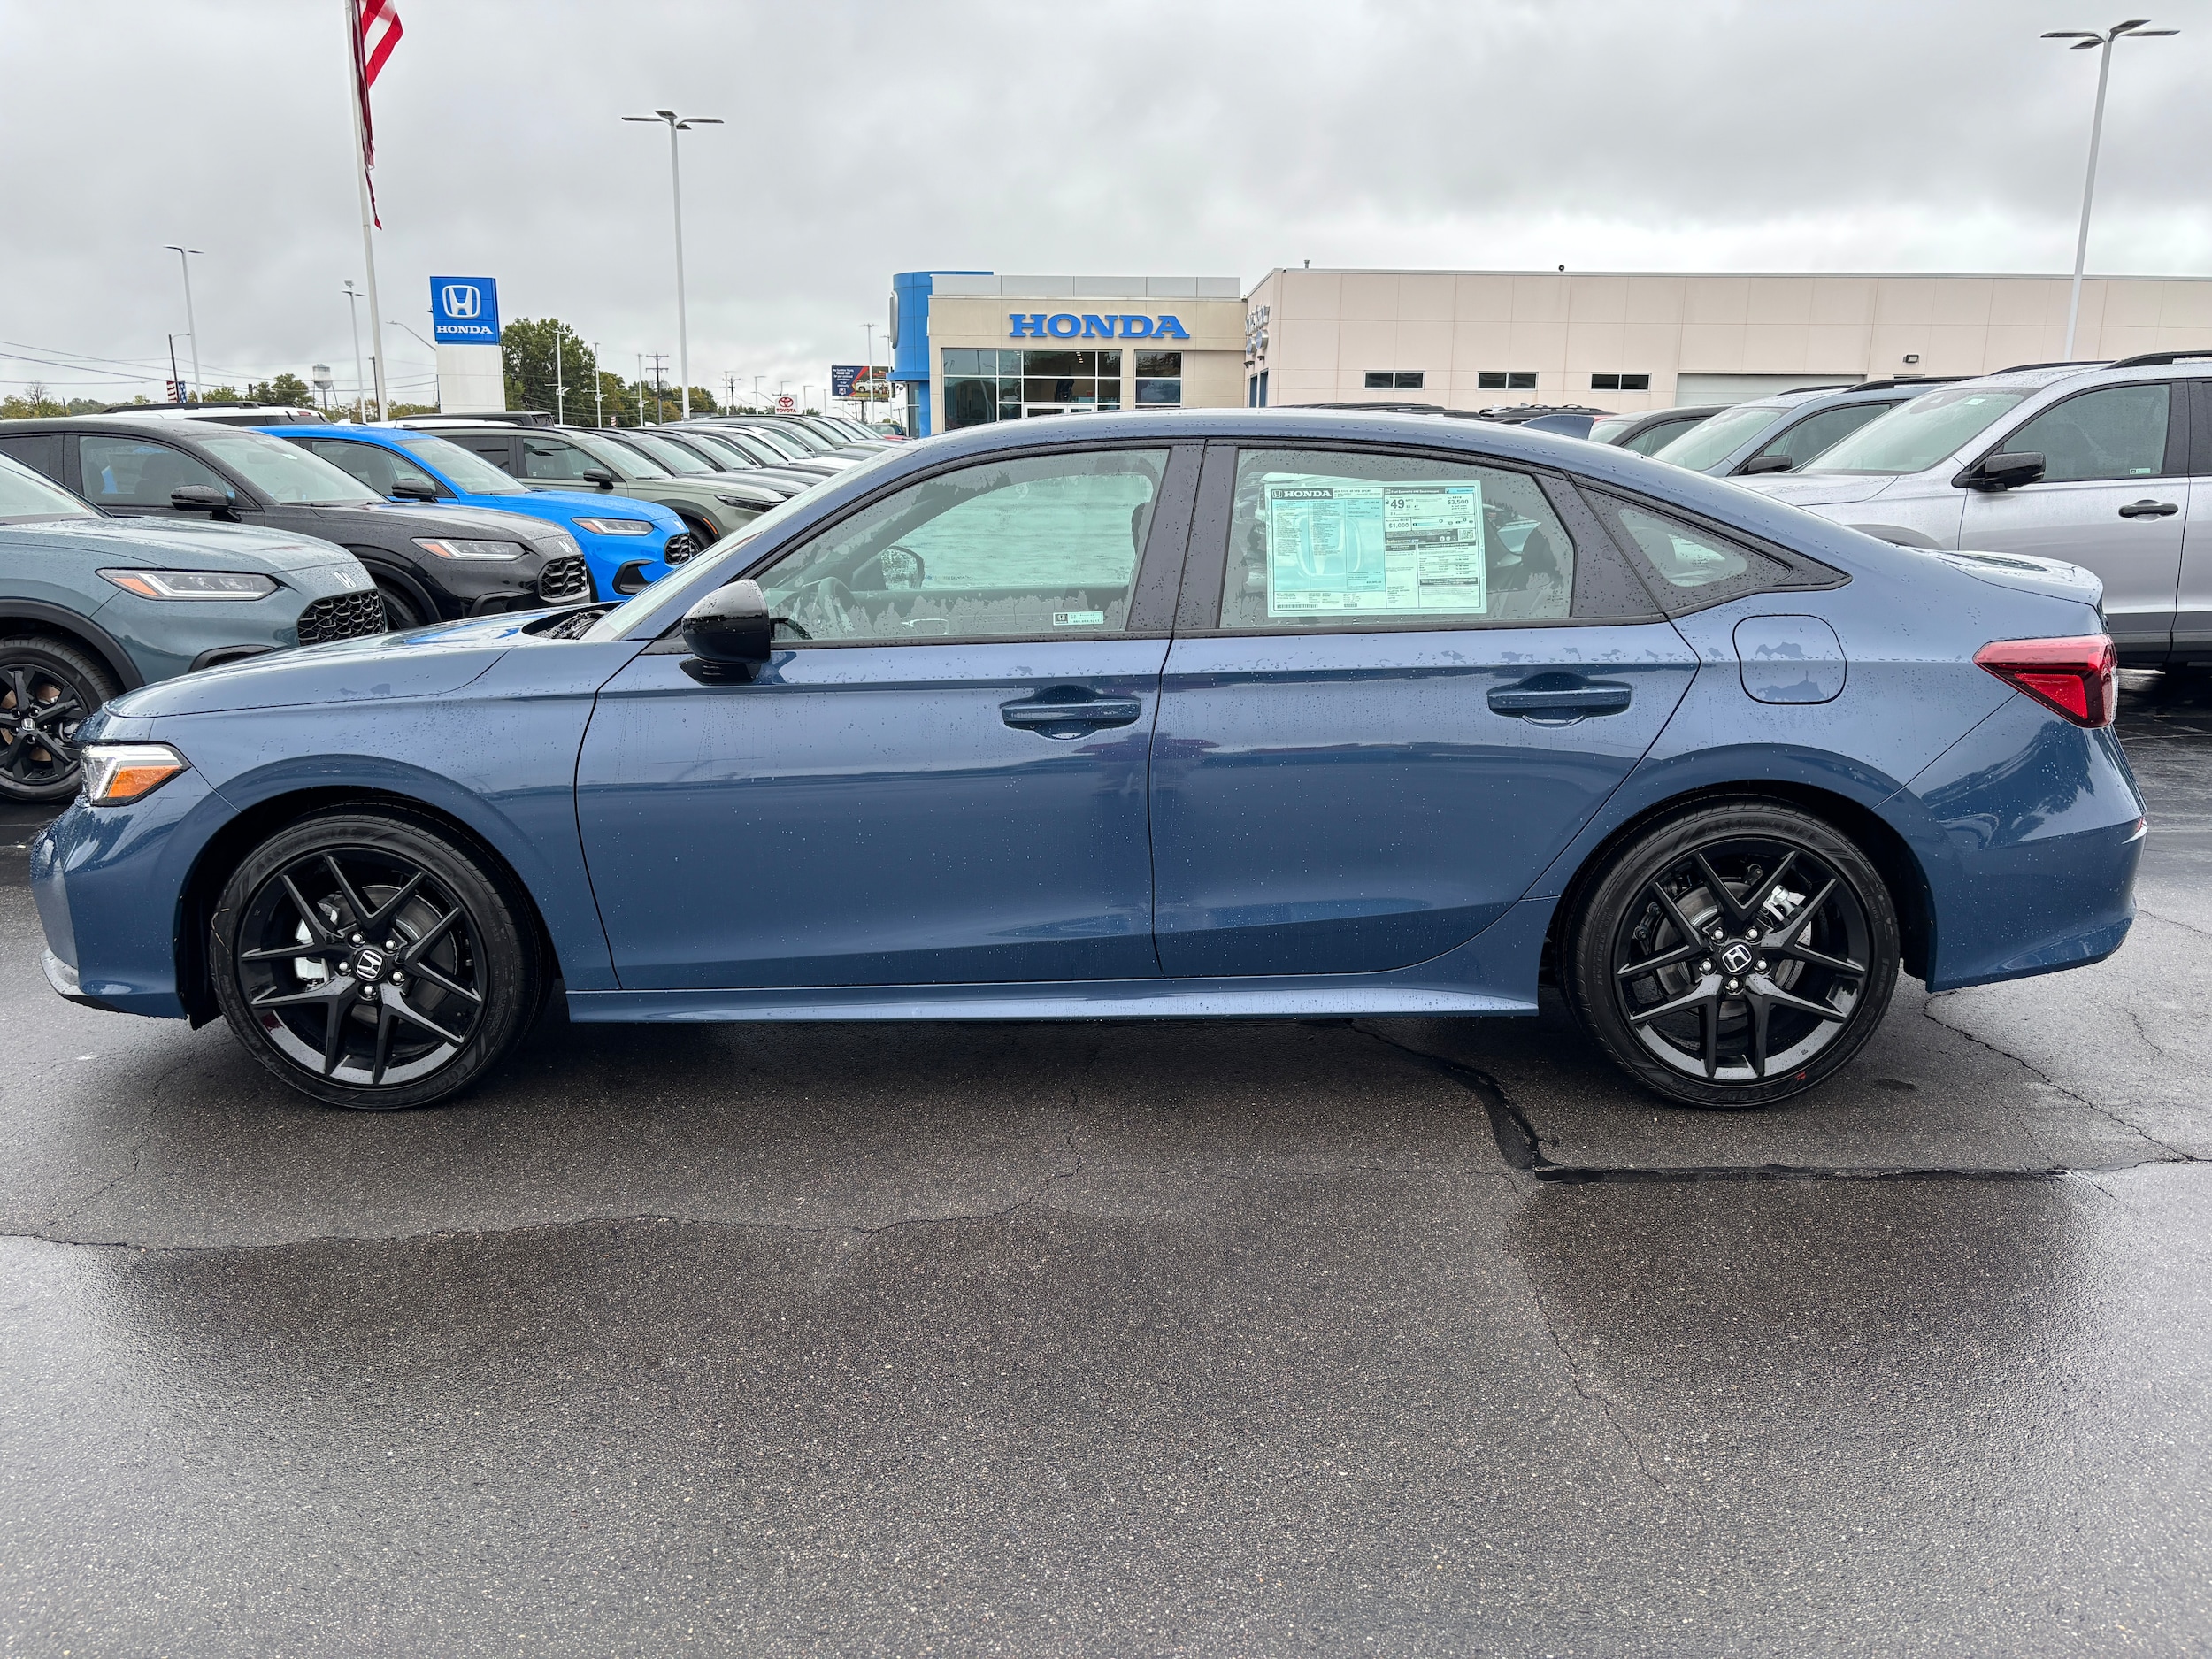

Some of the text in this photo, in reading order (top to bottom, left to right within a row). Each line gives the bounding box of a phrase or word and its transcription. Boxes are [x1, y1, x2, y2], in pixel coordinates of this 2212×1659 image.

[435, 325, 494, 334] HONDA
[1009, 313, 1190, 339] HONDA
[1390, 498, 1405, 509] 49
